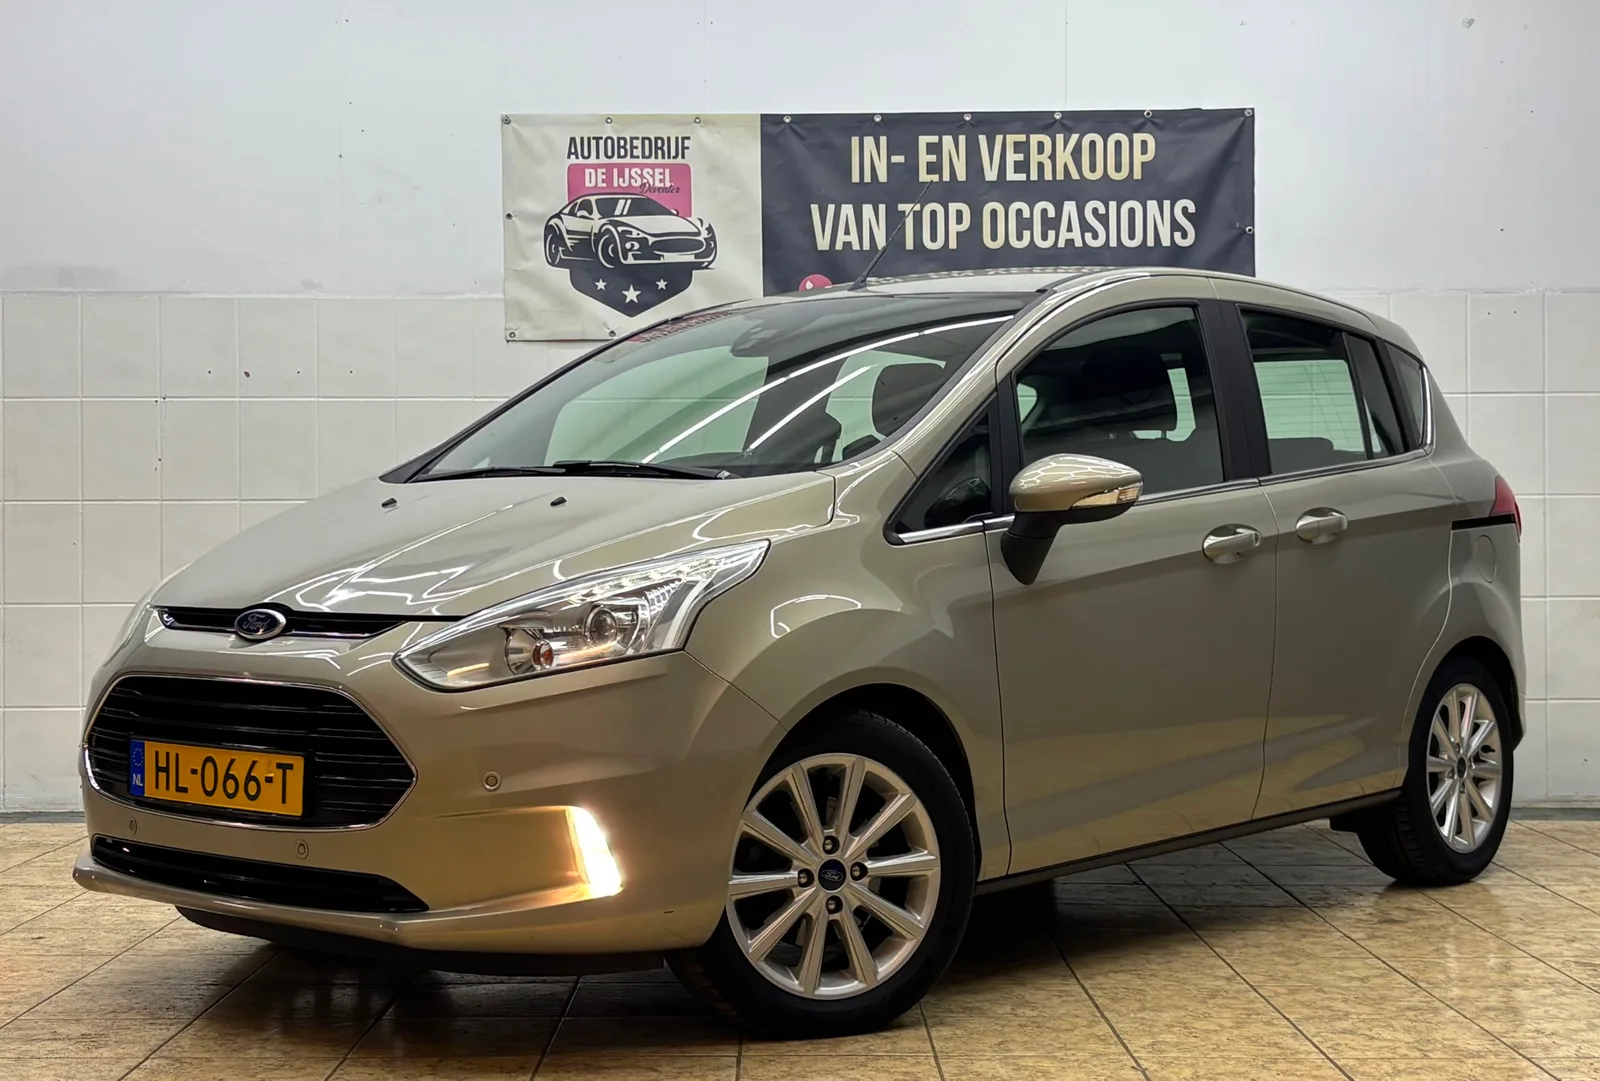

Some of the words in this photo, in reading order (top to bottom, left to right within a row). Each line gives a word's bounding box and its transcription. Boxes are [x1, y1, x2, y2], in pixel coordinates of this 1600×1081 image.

[566, 136, 692, 160] AUTOBEDRIJF
[850, 135, 905, 183] IN-
[918, 134, 967, 183] EN
[978, 132, 1157, 182] VERKOOP
[584, 168, 607, 188] DE
[612, 168, 675, 188] IJSSEL
[809, 202, 887, 251] VAN
[896, 201, 972, 251] TOP
[982, 198, 1197, 249] OCCASIONS
[242, 613, 272, 630] Ford
[132, 773, 144, 787] NL
[154, 750, 294, 804] HL-066-T
